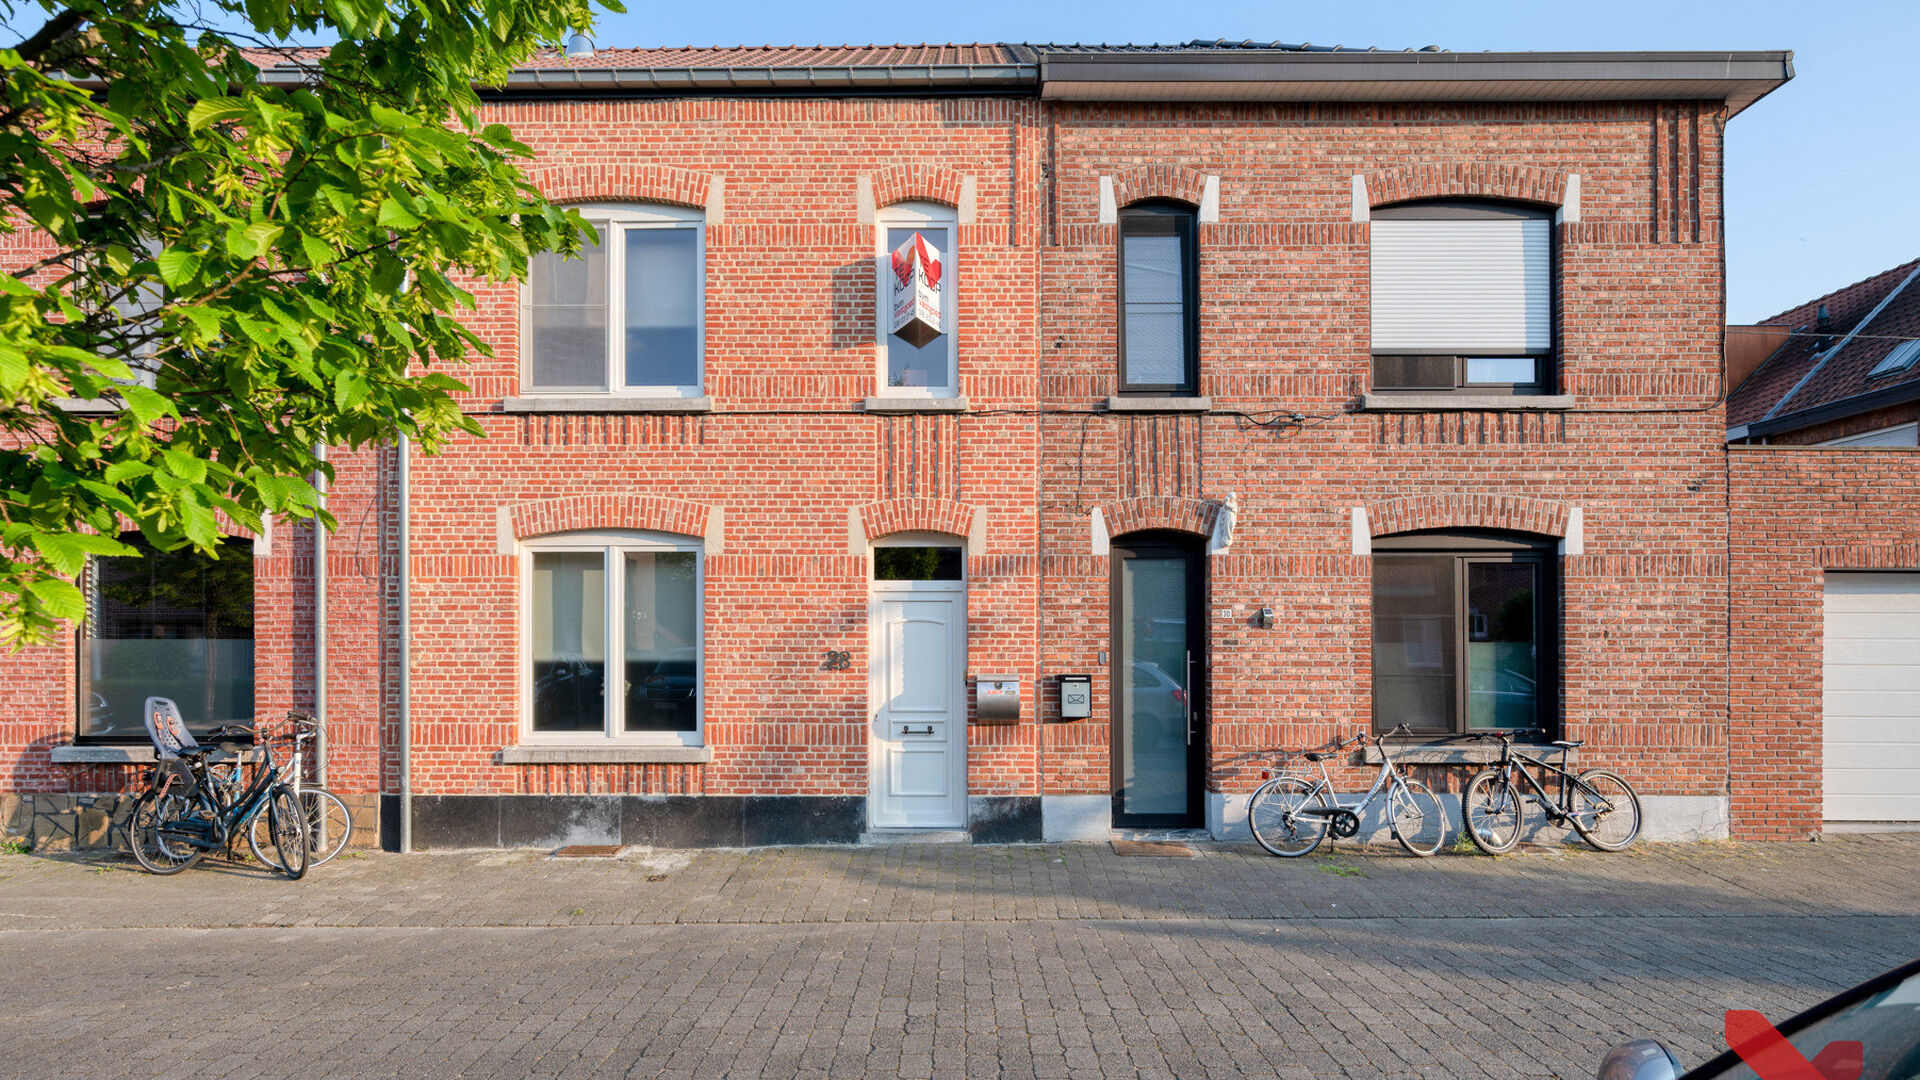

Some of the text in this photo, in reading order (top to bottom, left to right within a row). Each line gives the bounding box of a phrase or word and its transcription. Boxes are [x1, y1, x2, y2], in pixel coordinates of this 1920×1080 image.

[919, 254, 929, 271] TE
[893, 268, 915, 296] KOOP
[918, 268, 942, 294] KOOP
[824, 650, 851, 670] 28
